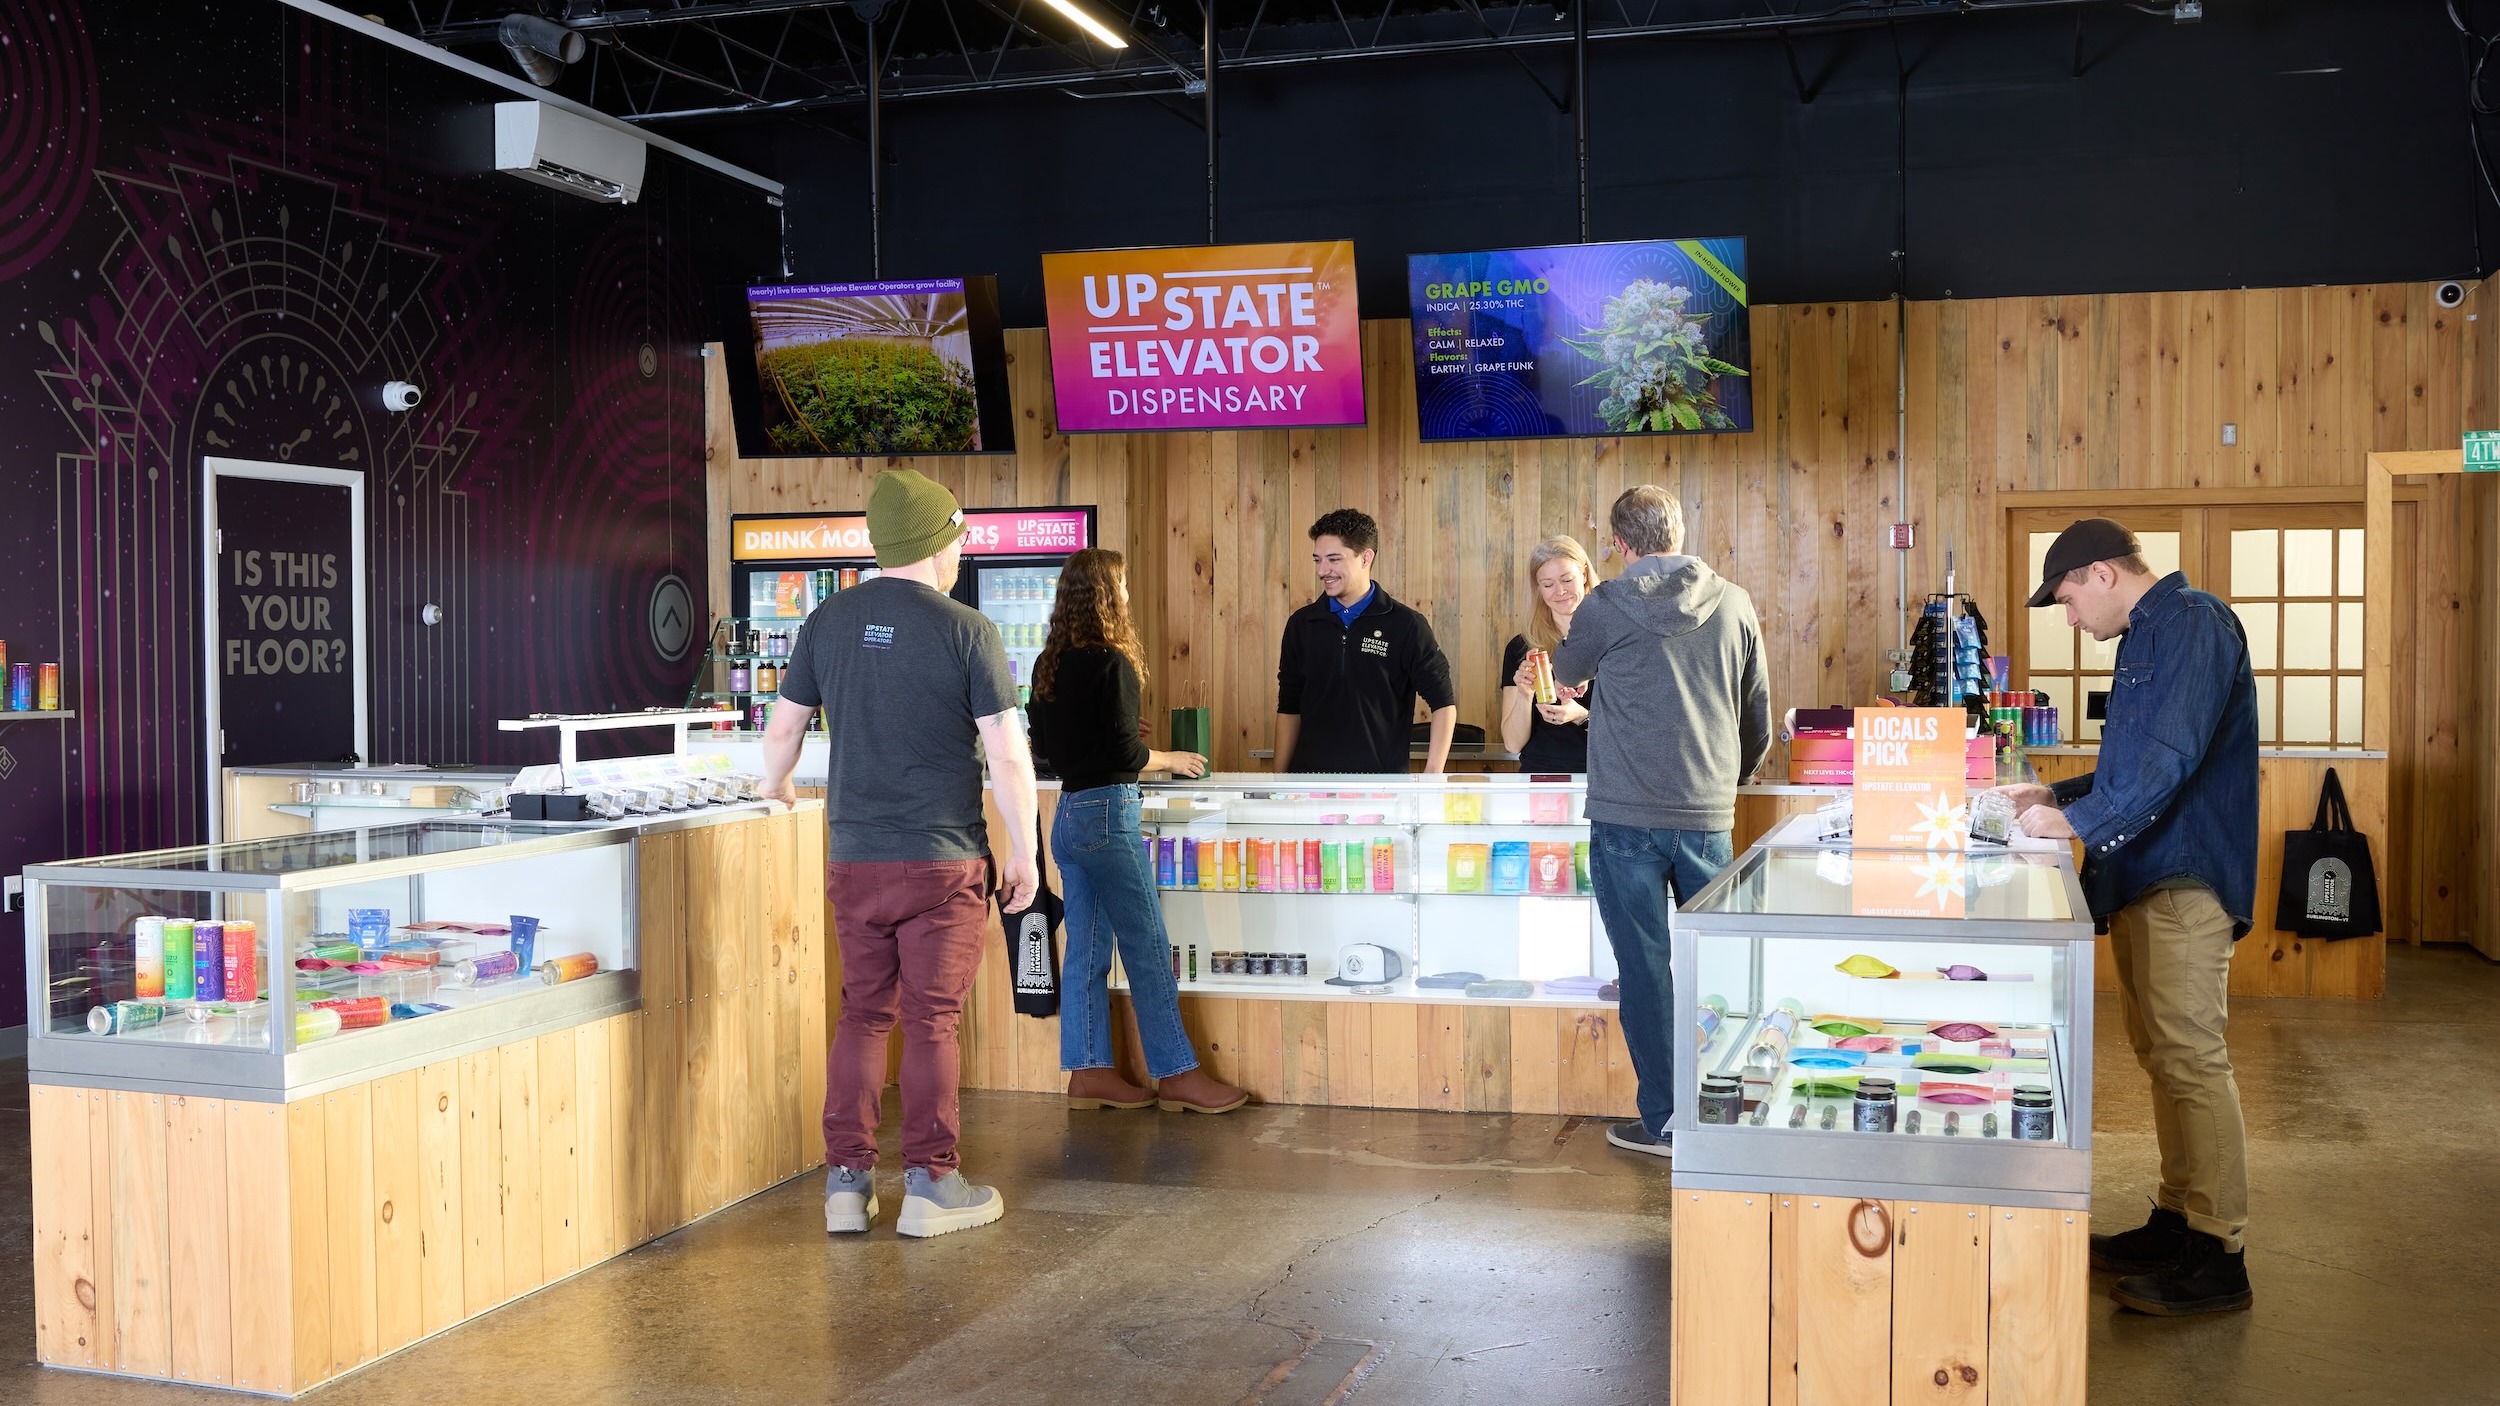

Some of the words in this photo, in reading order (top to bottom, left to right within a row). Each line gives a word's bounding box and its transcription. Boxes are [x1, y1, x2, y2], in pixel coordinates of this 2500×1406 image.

[1695, 250, 1721, 275] IN-HOUSE
[1720, 272, 1741, 293] FLOWER
[749, 286, 777, 296] (nearly)
[777, 286, 790, 294] live
[790, 285, 808, 294] from
[808, 285, 820, 293] the
[820, 284, 848, 294] Upstate
[878, 282, 915, 291] Operators
[916, 282, 935, 290] grow
[936, 279, 961, 289] facility
[1425, 281, 1492, 300] GRAPE
[1497, 277, 1550, 296] GMO
[1426, 302, 1460, 312] INDICA
[1469, 300, 1504, 311] 25.30%
[1505, 299, 1525, 308] THC
[1427, 327, 1463, 338] Effects:
[1428, 340, 1456, 350] CALM
[1464, 338, 1505, 348] RELAXED
[1089, 335, 1324, 378] ELEVATOR
[1429, 352, 1468, 362] Flavors:
[1430, 364, 1466, 374] EARTHY
[1474, 363, 1506, 373] GRAPE
[1508, 361, 1534, 371] FUNK
[1108, 384, 1308, 416] DISPENSARY
[1017, 519, 1076, 535] UPSTATE
[745, 527, 818, 550] DRINK
[1017, 535, 1077, 547] ELEVATOR
[234, 550, 263, 587] IS
[270, 552, 338, 589] THIS
[240, 594, 333, 631] YOUR
[866, 624, 894, 633] UPSTATE
[1361, 643, 1388, 653] ELEVATOR
[1363, 637, 1389, 648] UPSTATE
[226, 638, 347, 675] FLOOR?
[1862, 717, 1938, 741] LOCALS
[1862, 741, 1909, 767] PICK
[1861, 782, 1895, 792] UPSTATE
[1895, 782, 1932, 792] ELEVATOR
